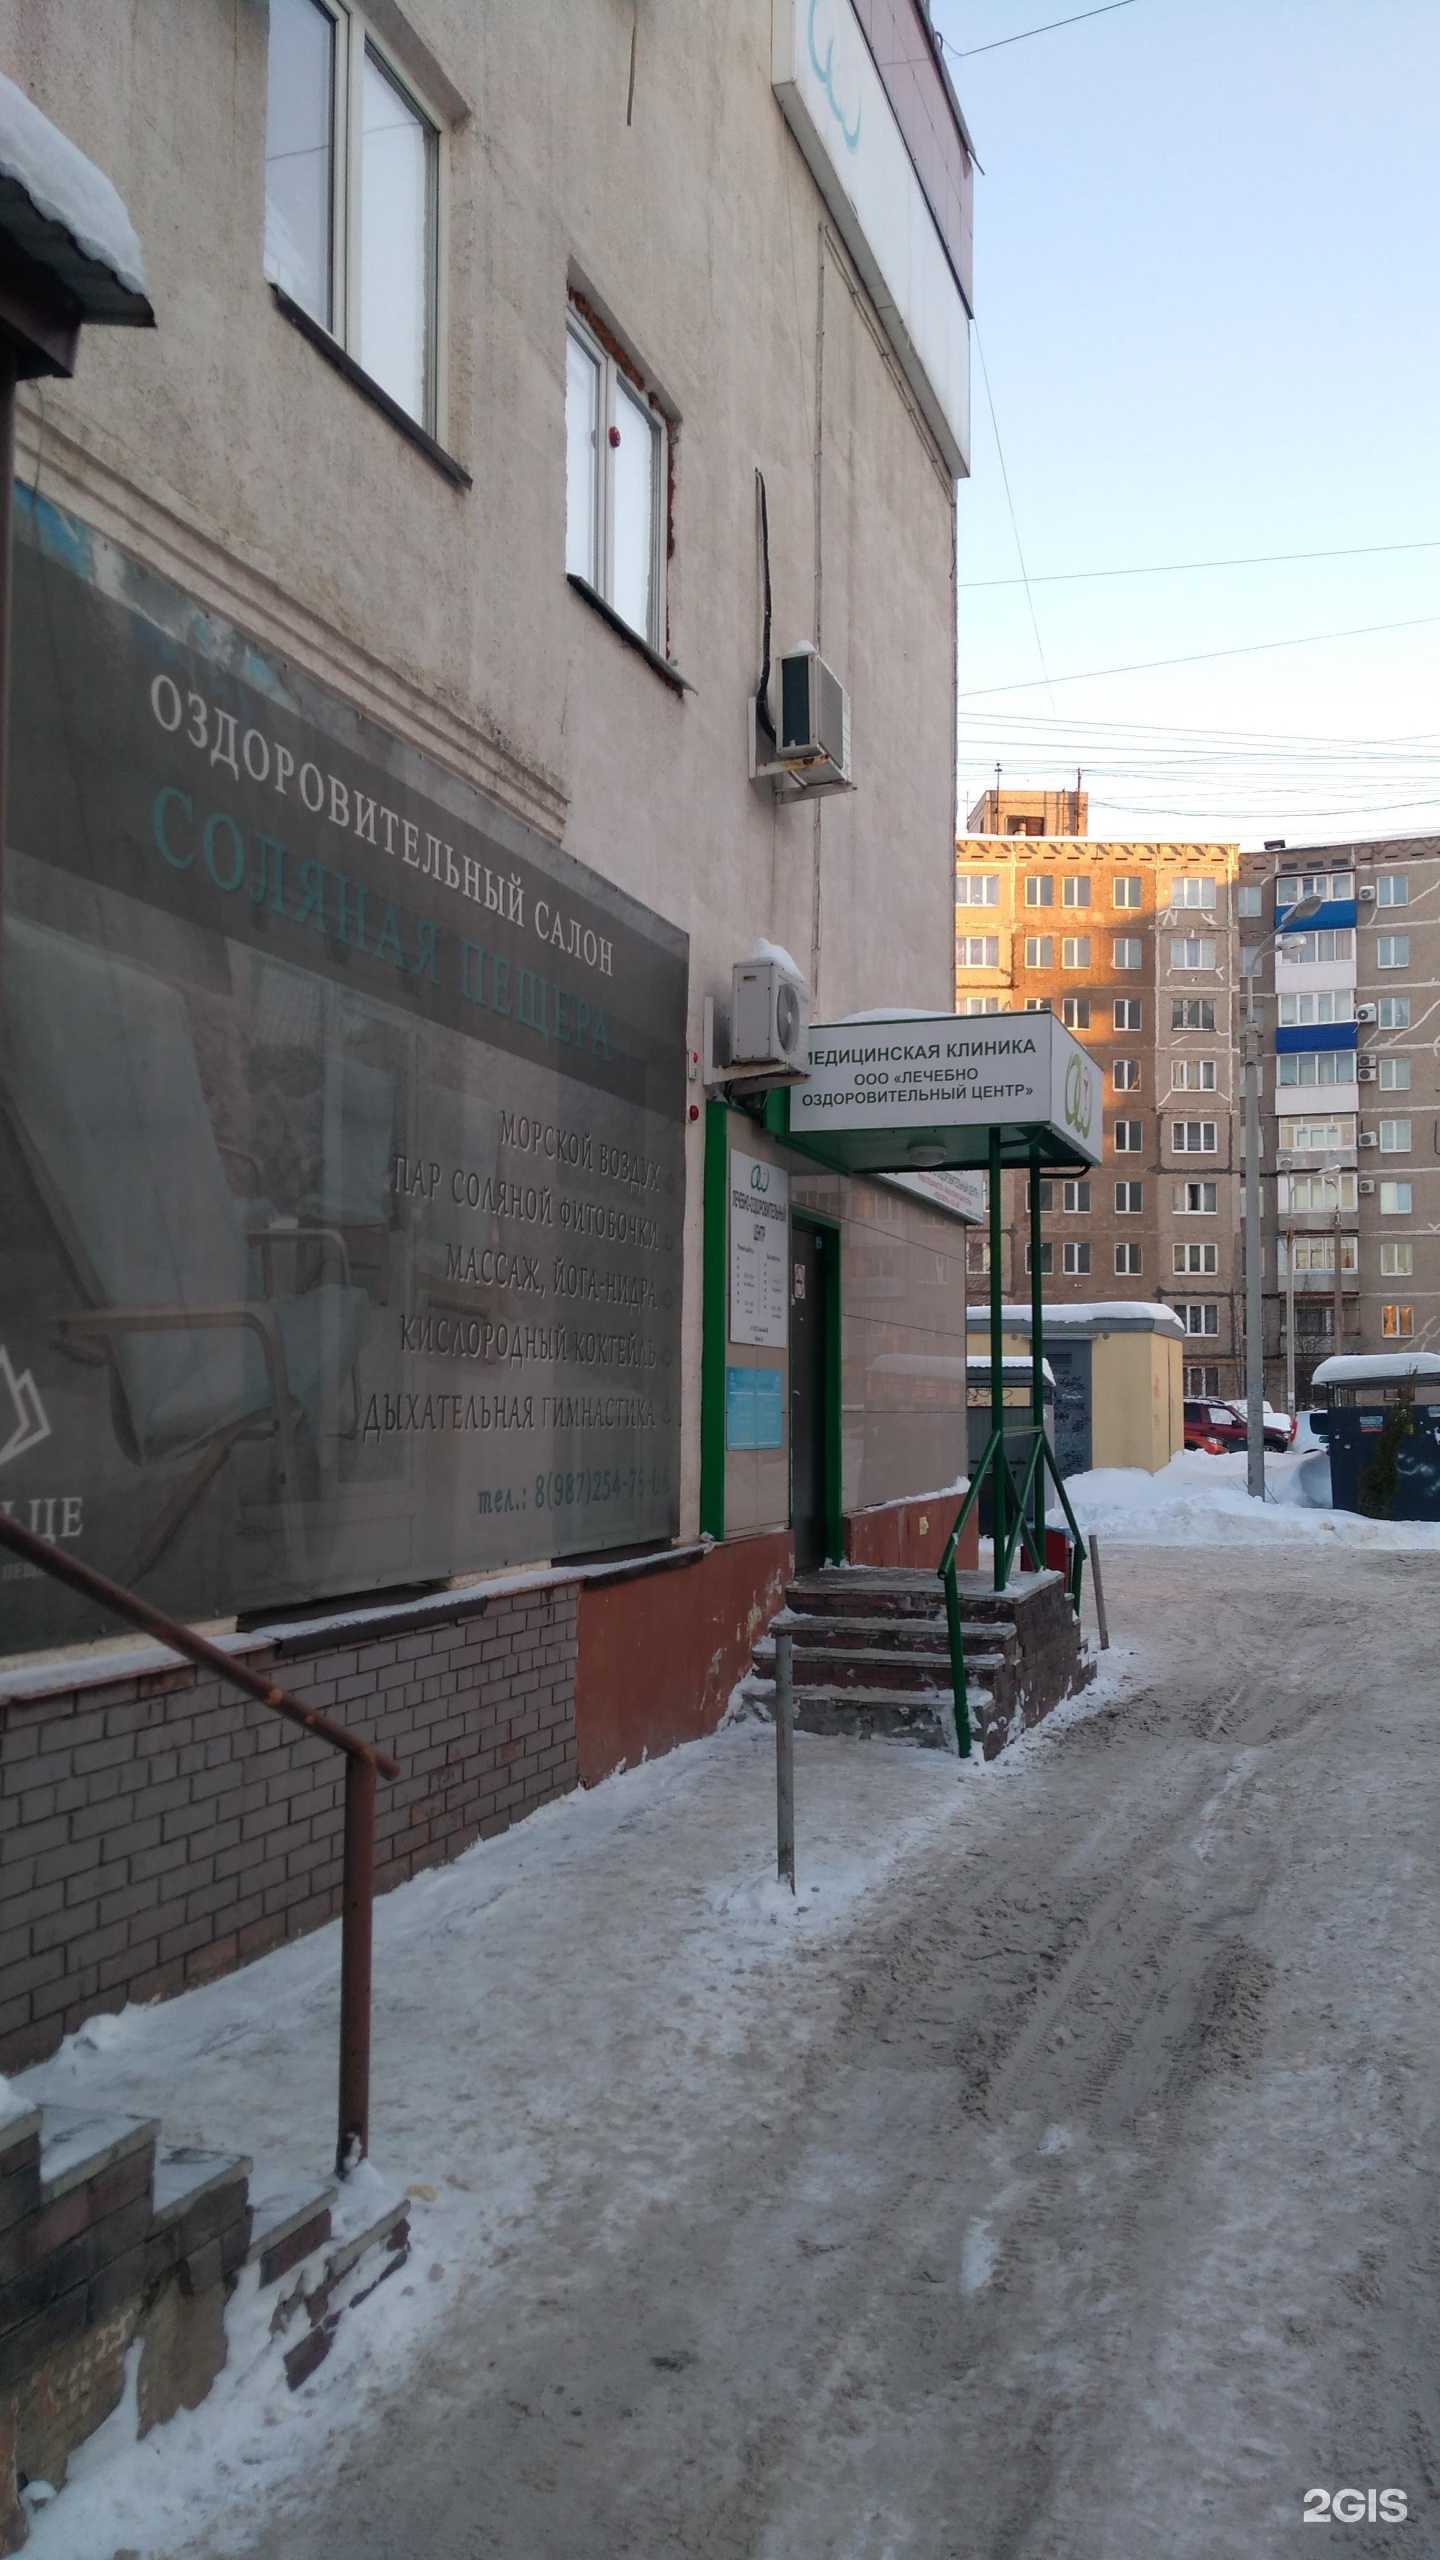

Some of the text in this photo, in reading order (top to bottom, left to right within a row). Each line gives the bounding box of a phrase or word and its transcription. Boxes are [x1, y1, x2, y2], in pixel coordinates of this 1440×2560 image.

[150, 674, 614, 977] ОЗДОРОВИТЕЛЬНЫЙ САЛОН
[152, 785, 611, 1057] СОЛЯНАЯ ПЕЩЕРА
[946, 1038, 1036, 1058] КЛИНИКА
[801, 1083, 1034, 1108] ОЗДОРОВИТЕЛЬНЫЙ ЦЕНТР»
[853, 1067, 978, 1087] ООО «ЛЕЧЕБНО
[499, 1109, 663, 1194] МОРСКОЙ ВОЗДУХ
[391, 1153, 442, 1201] ПАР
[451, 1168, 553, 1227] СОЛЯНОЙ
[446, 1242, 660, 1316] МАССАЖ, ЙОГА-НИДРА
[400, 1314, 657, 1371] КИСЛОРОДНЫЙ КОКТЕЙЛЬ
[362, 1393, 657, 1445] ДЫХАТЕЛЬНАЯ ГИМНАСТИКА
[478, 1487, 528, 1515] тел.:
